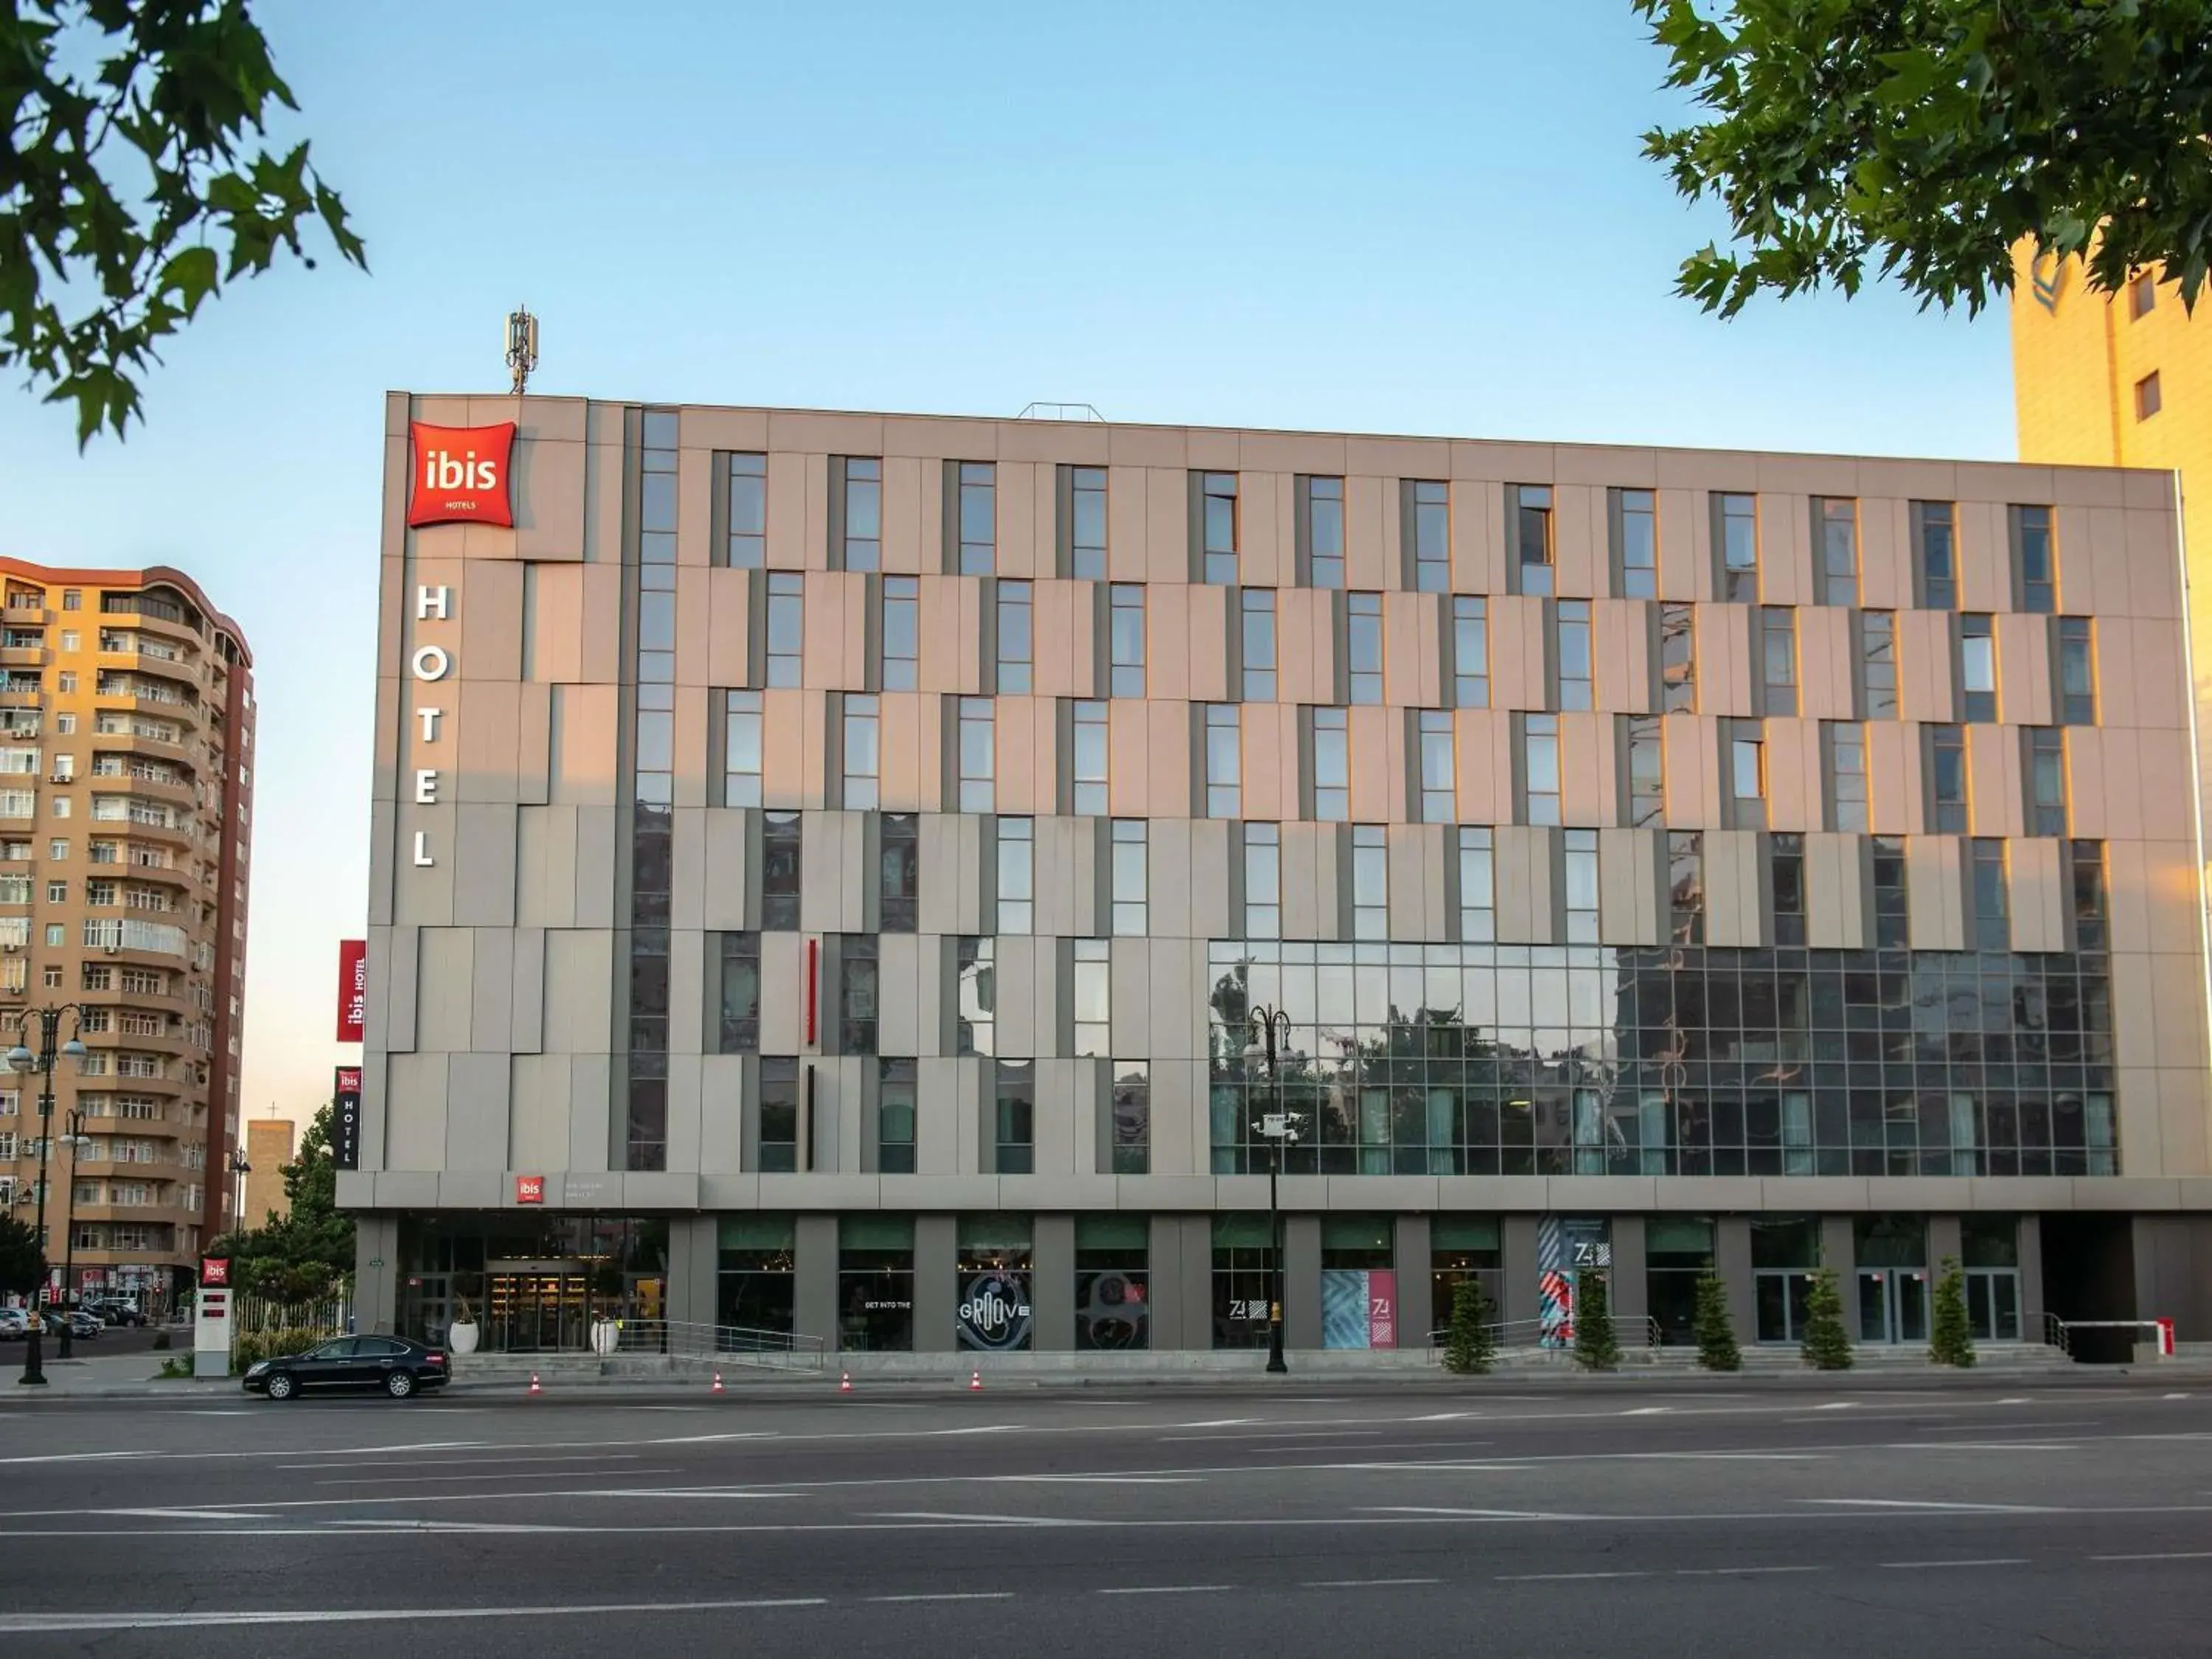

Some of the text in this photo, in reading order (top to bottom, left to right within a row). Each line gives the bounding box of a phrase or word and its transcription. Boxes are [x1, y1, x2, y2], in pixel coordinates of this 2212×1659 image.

[427, 451, 496, 490] ibis
[445, 501, 476, 509] HOTELS
[412, 585, 448, 866] HOTEL
[347, 958, 365, 1024] ibis HOTEL
[341, 1076, 358, 1086] ibis
[344, 1101, 354, 1163] HOTEL
[520, 1182, 540, 1194] ibis
[206, 1265, 225, 1276] ibis
[959, 1291, 1031, 1330] GROOVE
